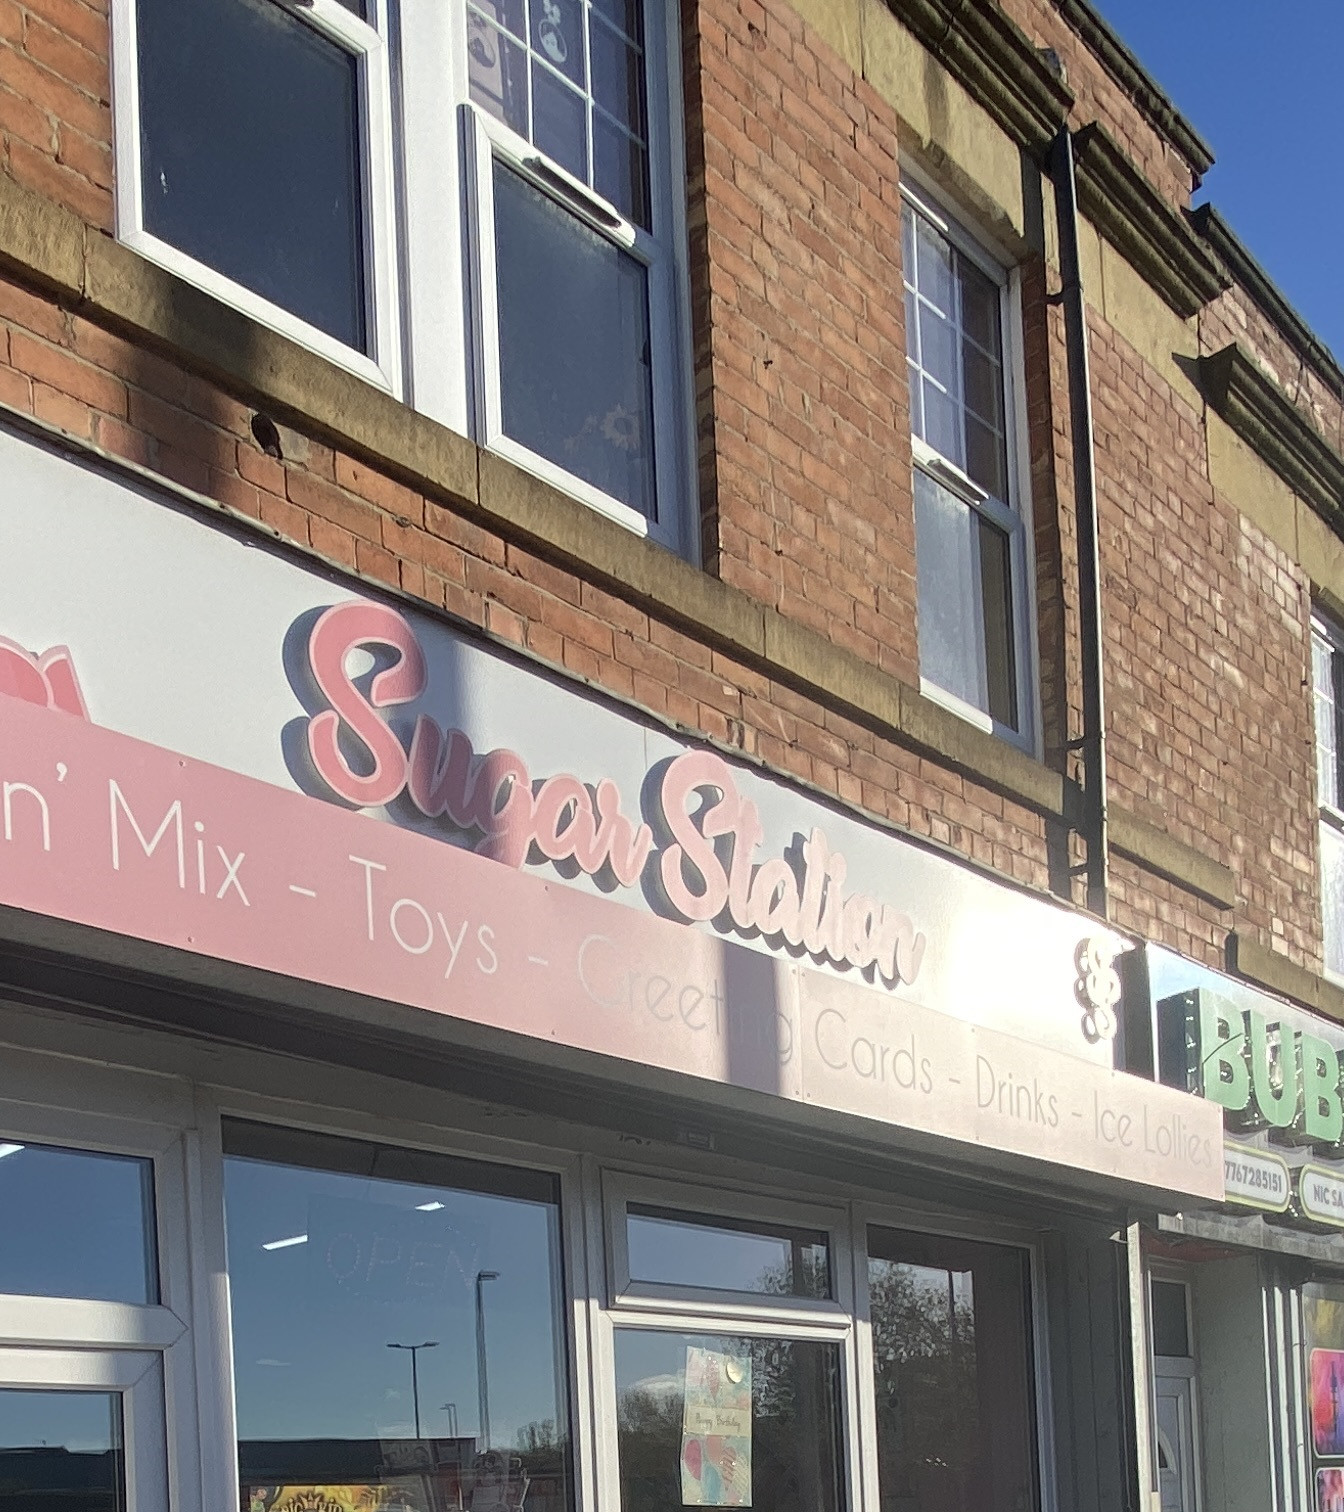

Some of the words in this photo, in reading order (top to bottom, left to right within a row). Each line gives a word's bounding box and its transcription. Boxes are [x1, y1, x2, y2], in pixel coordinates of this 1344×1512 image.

[109, 779, 252, 907] Mix
[349, 855, 498, 979] Toys
[815, 1008, 933, 1094] Cards
[977, 1054, 1060, 1128] Drinks
[1094, 1090, 1133, 1148] Ice
[1143, 1111, 1215, 1169] Lollies
[306, 600, 652, 888] Sugar
[661, 749, 926, 987] Station
[1312, 1183, 1330, 1204] NIC
